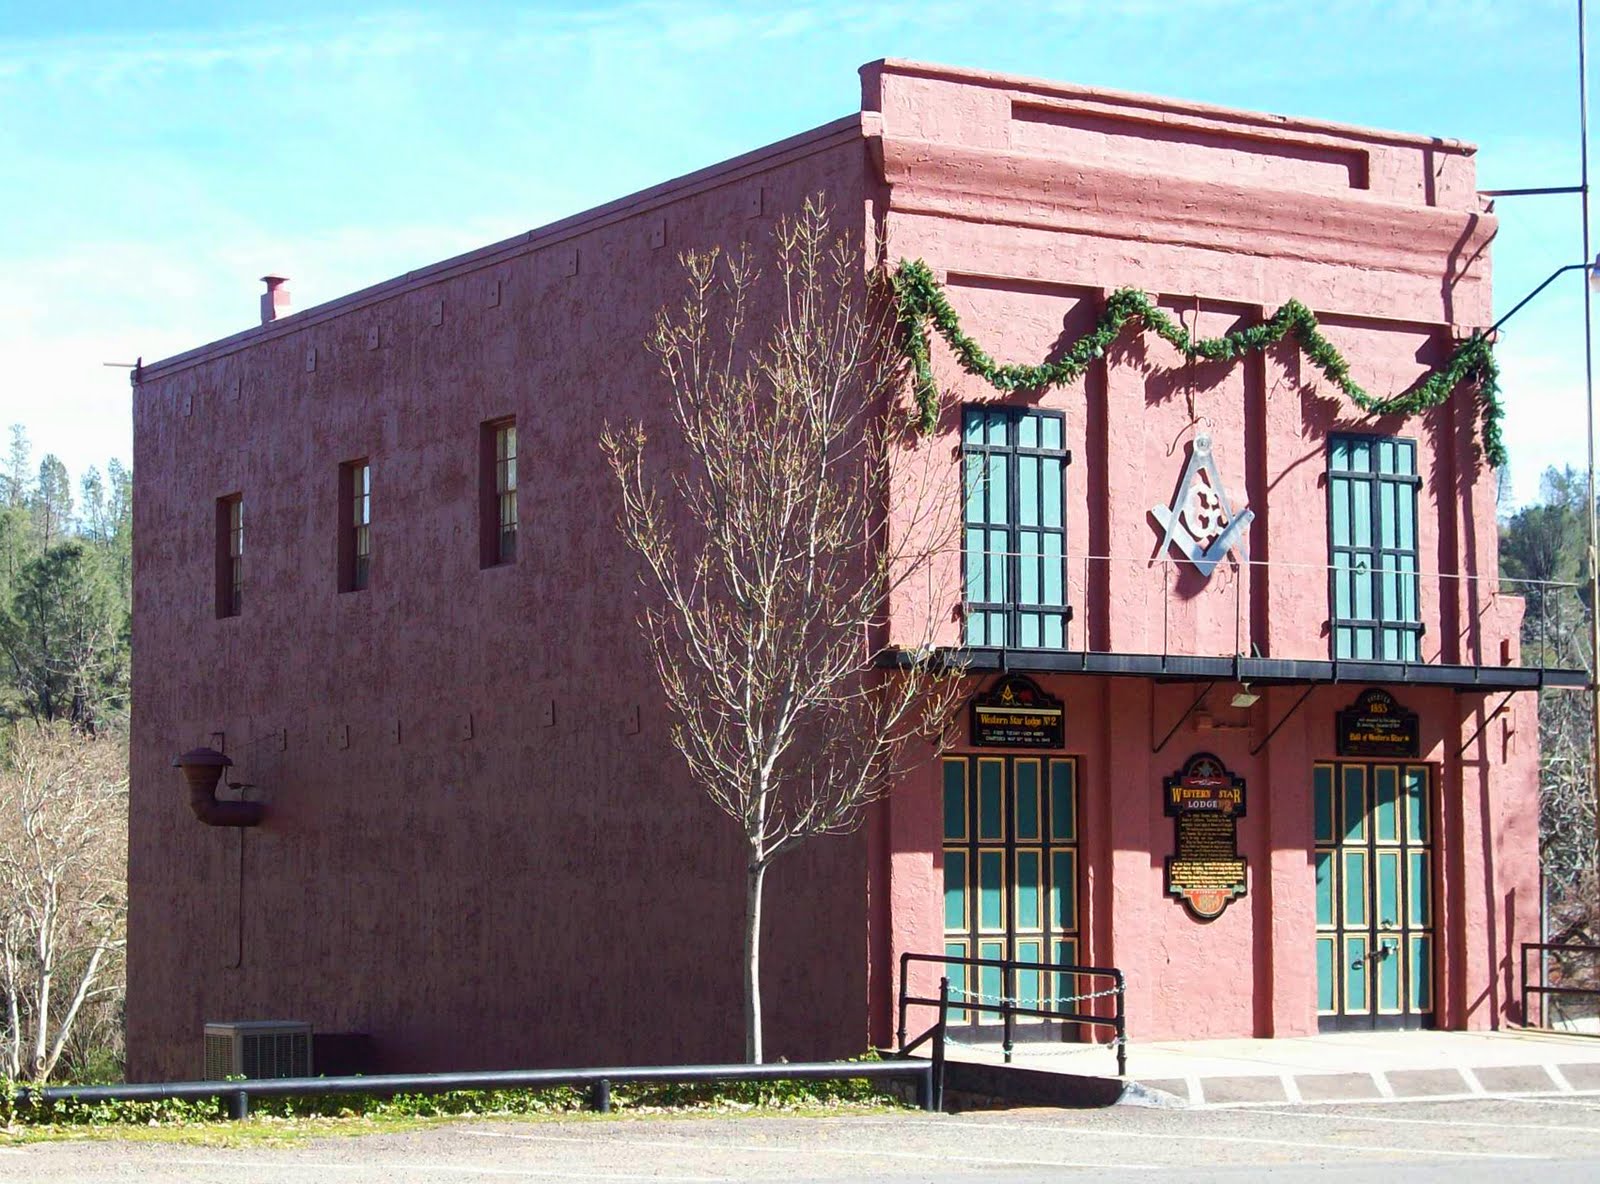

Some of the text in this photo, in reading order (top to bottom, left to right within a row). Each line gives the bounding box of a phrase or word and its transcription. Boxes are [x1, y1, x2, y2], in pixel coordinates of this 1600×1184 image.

[980, 713, 1009, 725] Western
[1009, 714, 1025, 726] Star
[1024, 715, 1042, 727] Lodge
[1172, 788, 1241, 803] WESTERN STAR
[1188, 800, 1217, 809] LODGE
